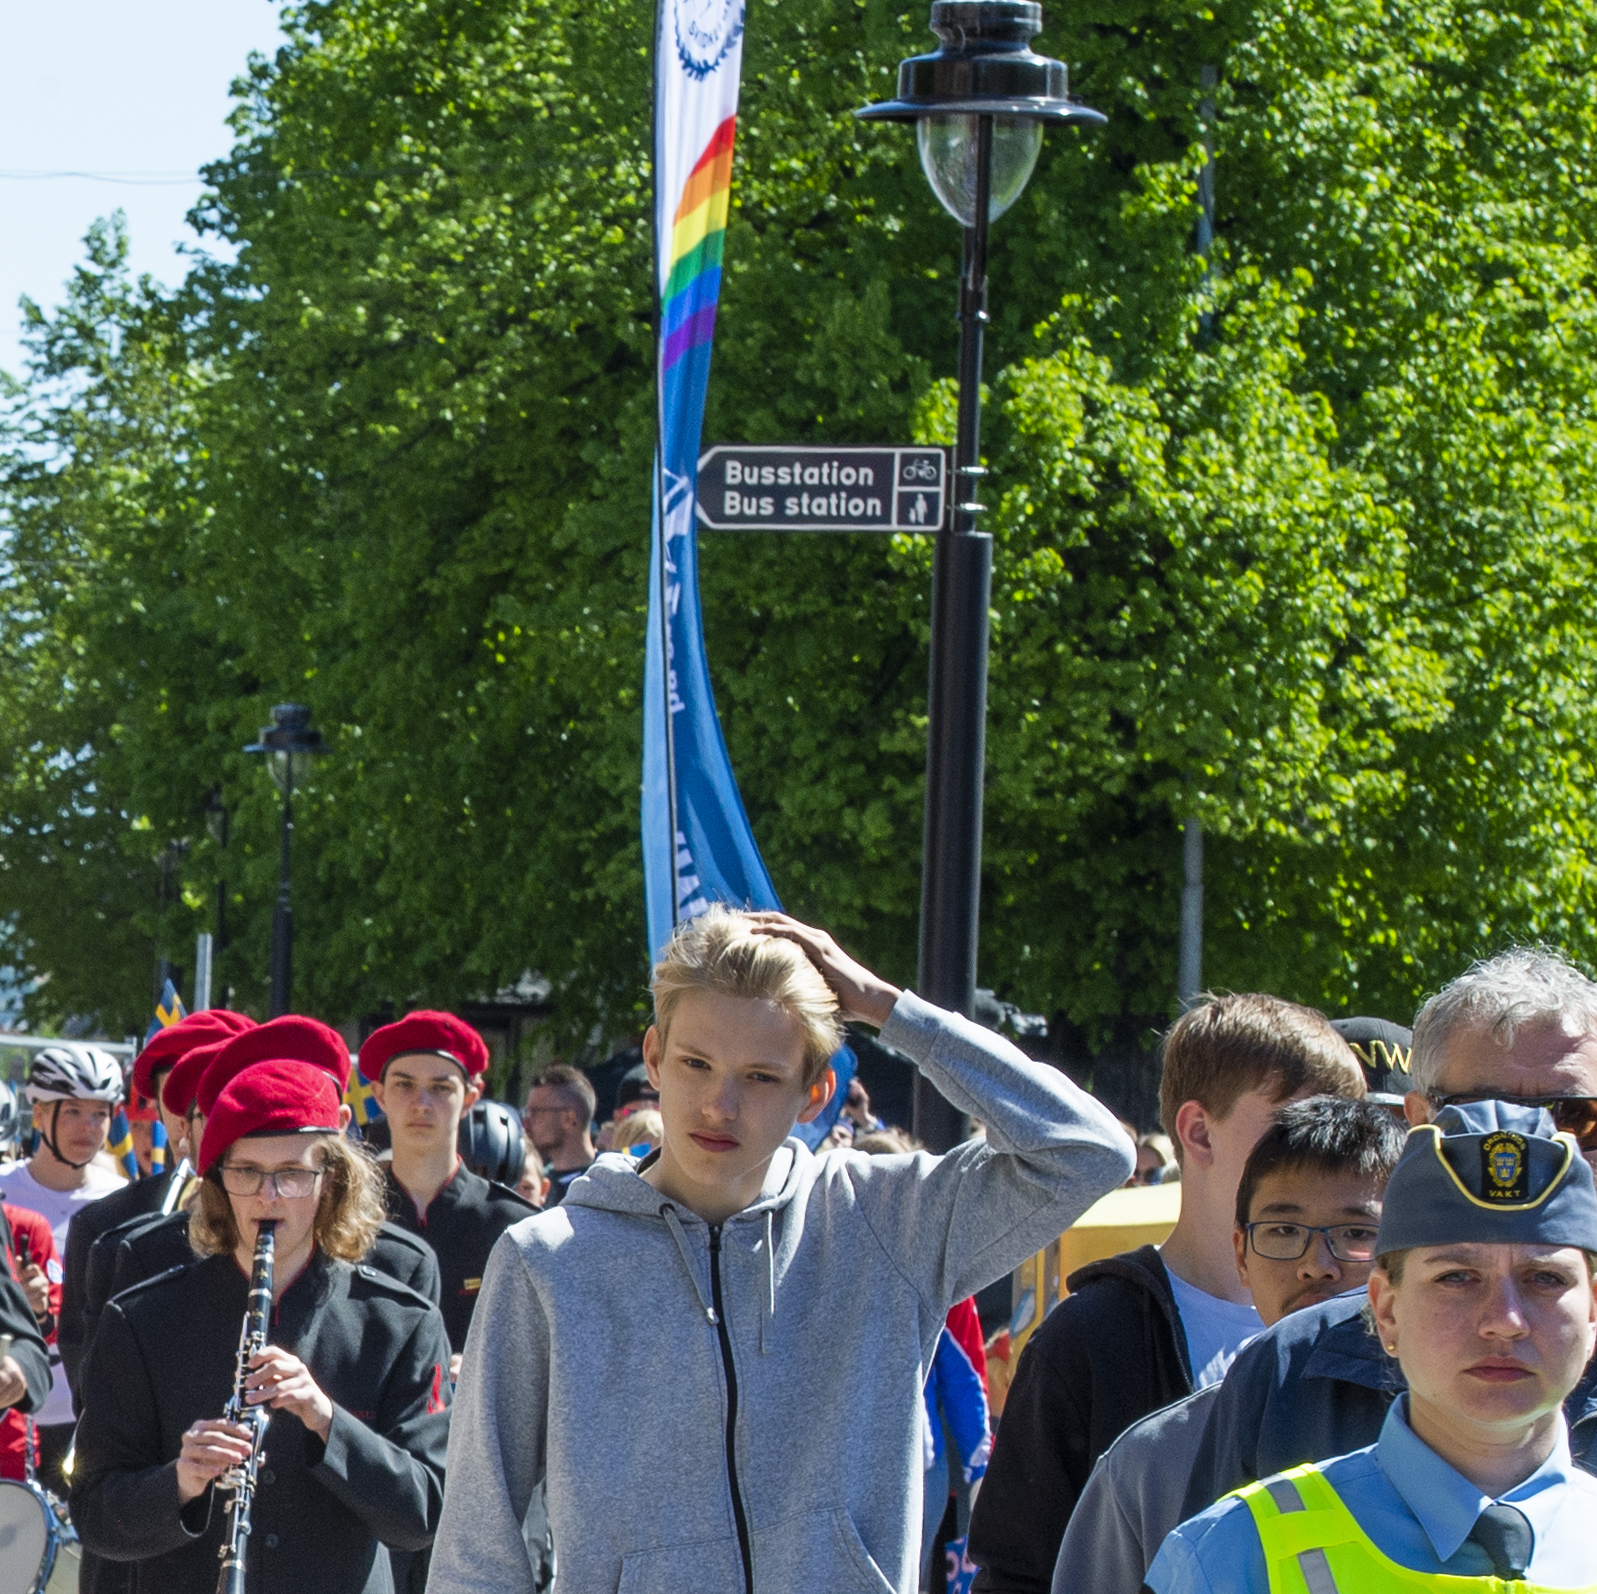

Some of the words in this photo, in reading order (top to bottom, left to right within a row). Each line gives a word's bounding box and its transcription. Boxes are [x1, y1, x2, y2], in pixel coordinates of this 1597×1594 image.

[725, 460, 874, 486] Busstation
[724, 491, 775, 516] Bus
[784, 491, 882, 516] station
[1489, 1189, 1521, 1198] VAKT
